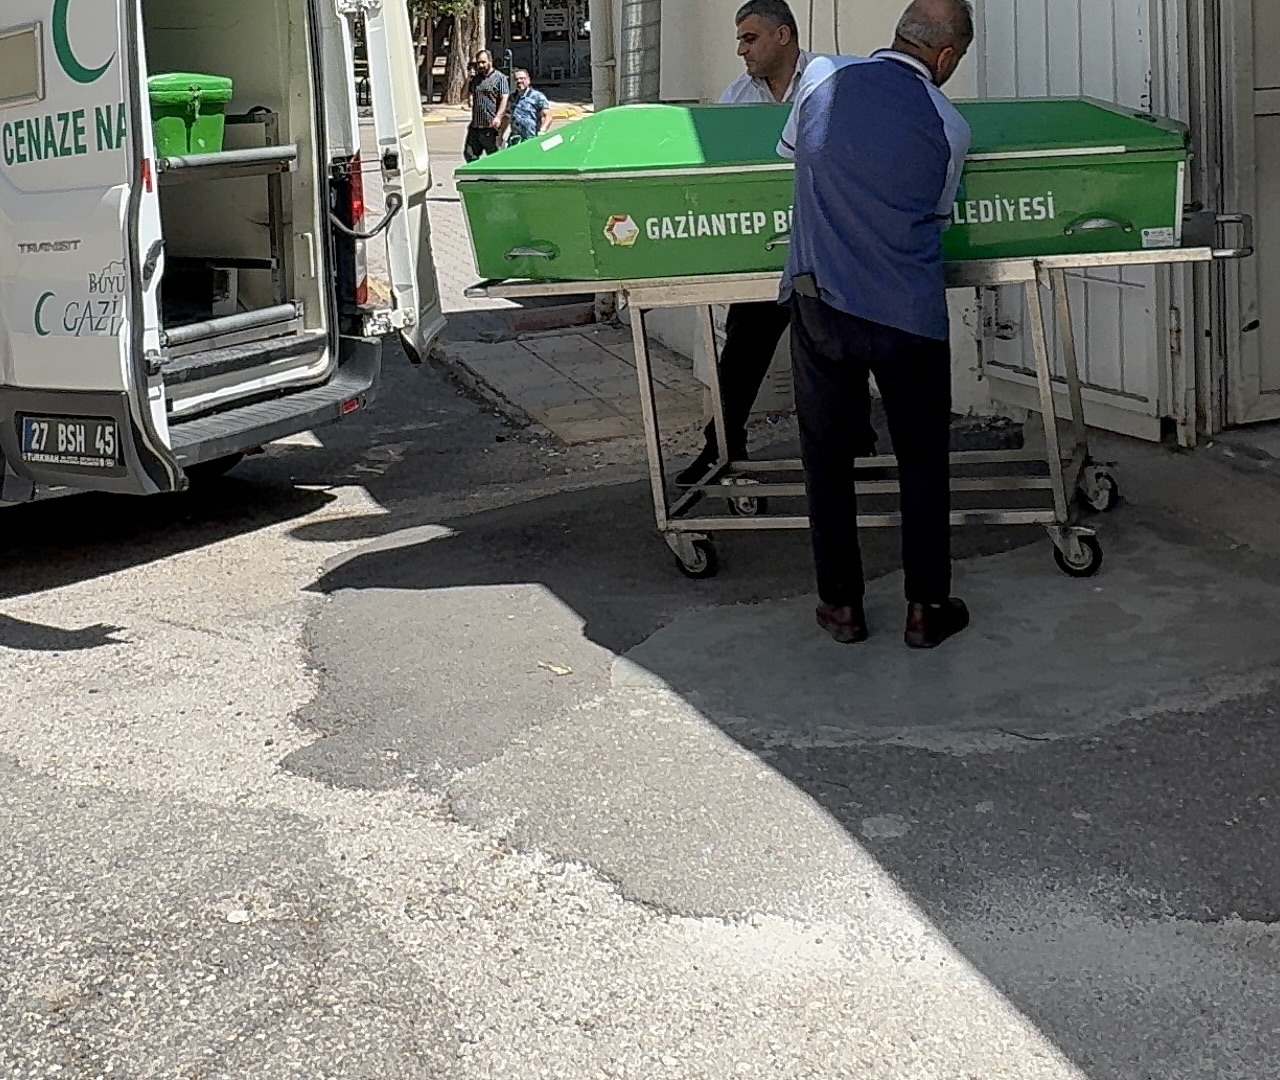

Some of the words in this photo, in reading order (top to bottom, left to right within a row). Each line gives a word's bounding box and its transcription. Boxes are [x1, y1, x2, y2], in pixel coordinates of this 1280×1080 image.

[3, 109, 87, 165] CENAZE
[645, 210, 766, 240] GAZİANTEP
[953, 191, 1054, 225] LEDİYESİ
[31, 422, 48, 451] 27
[58, 423, 85, 453] BSH
[95, 425, 114, 455] 45
